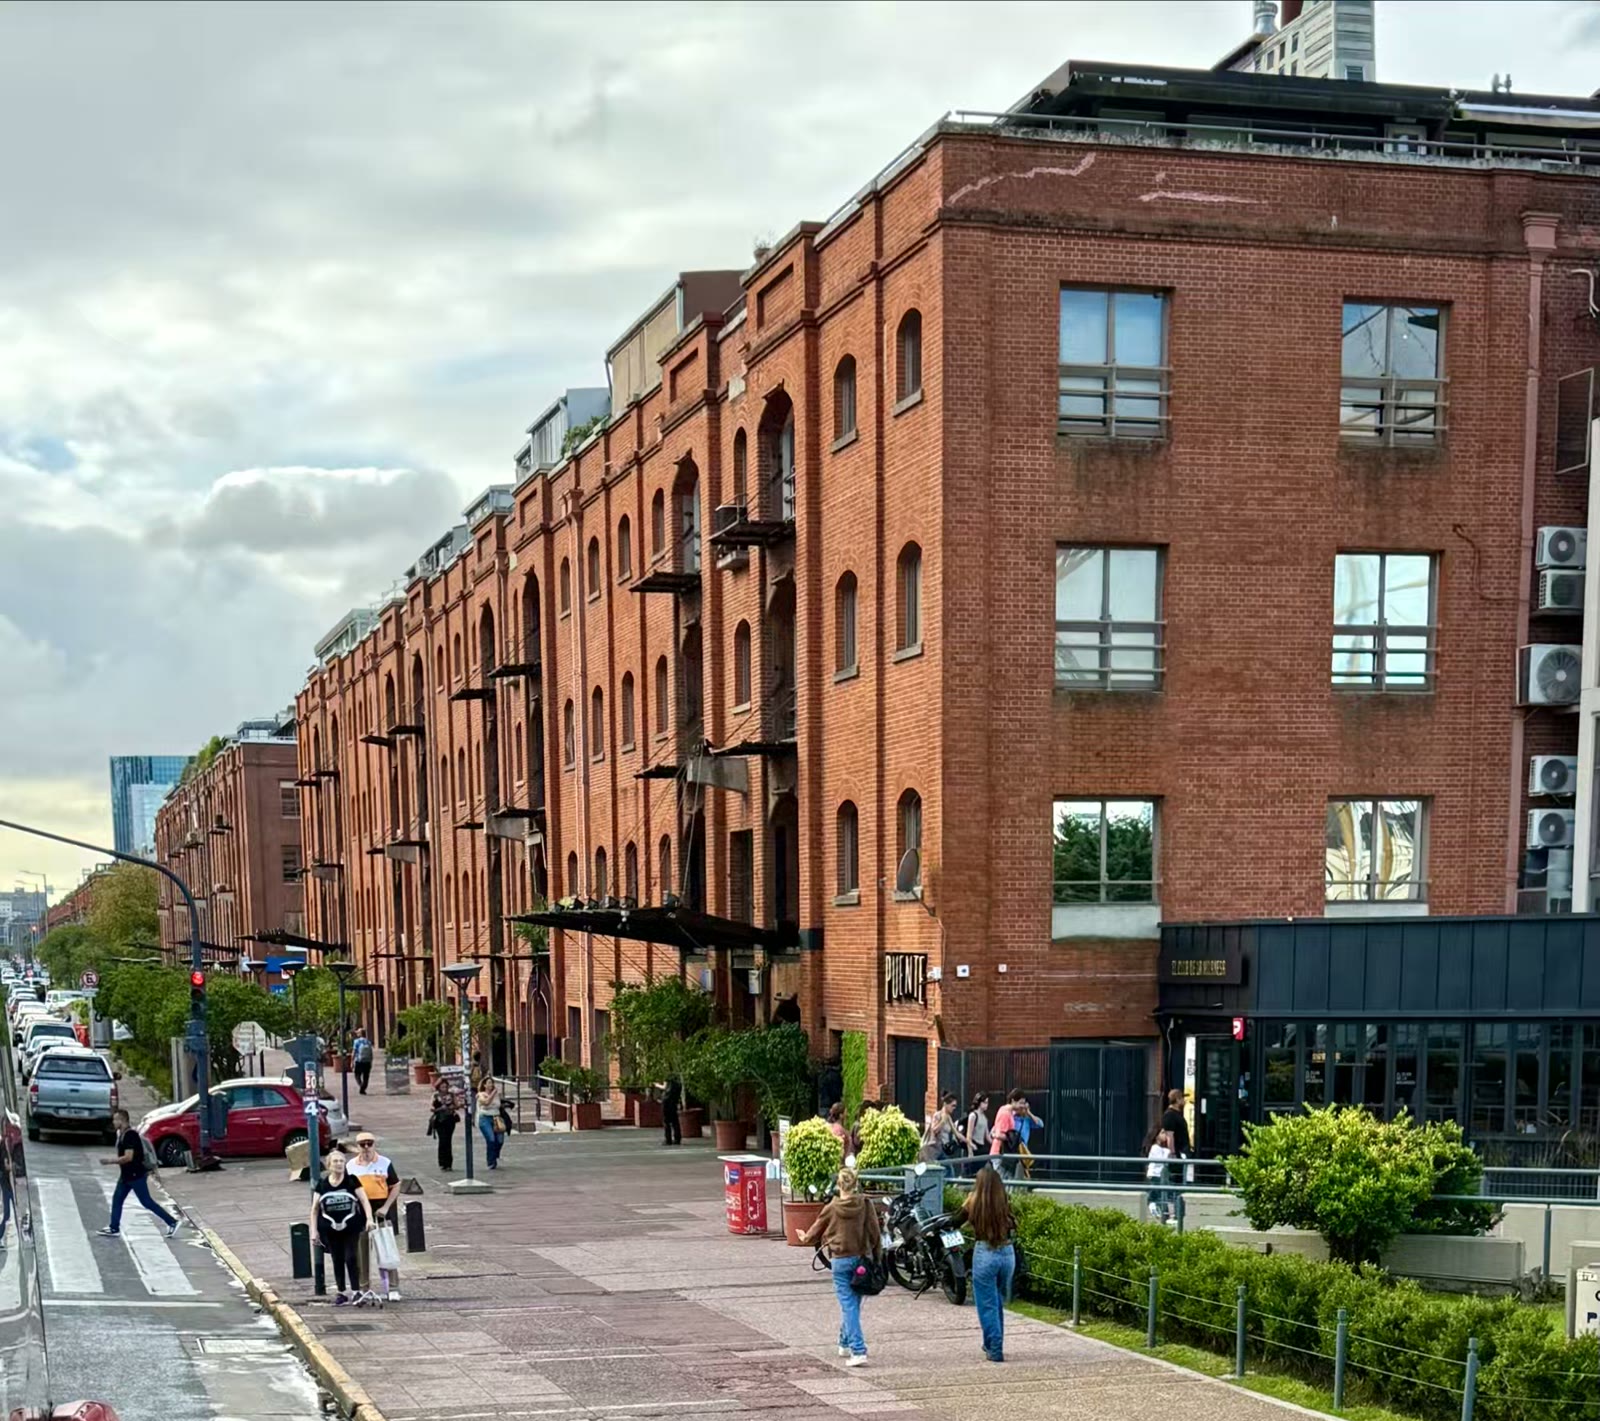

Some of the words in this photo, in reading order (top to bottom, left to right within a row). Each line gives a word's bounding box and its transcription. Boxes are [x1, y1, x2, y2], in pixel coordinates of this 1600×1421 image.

[885, 955, 925, 1005] PUENTE
[305, 1075, 317, 1089] 20
[304, 1101, 319, 1116] 4
[1587, 1312, 1600, 1324] P
